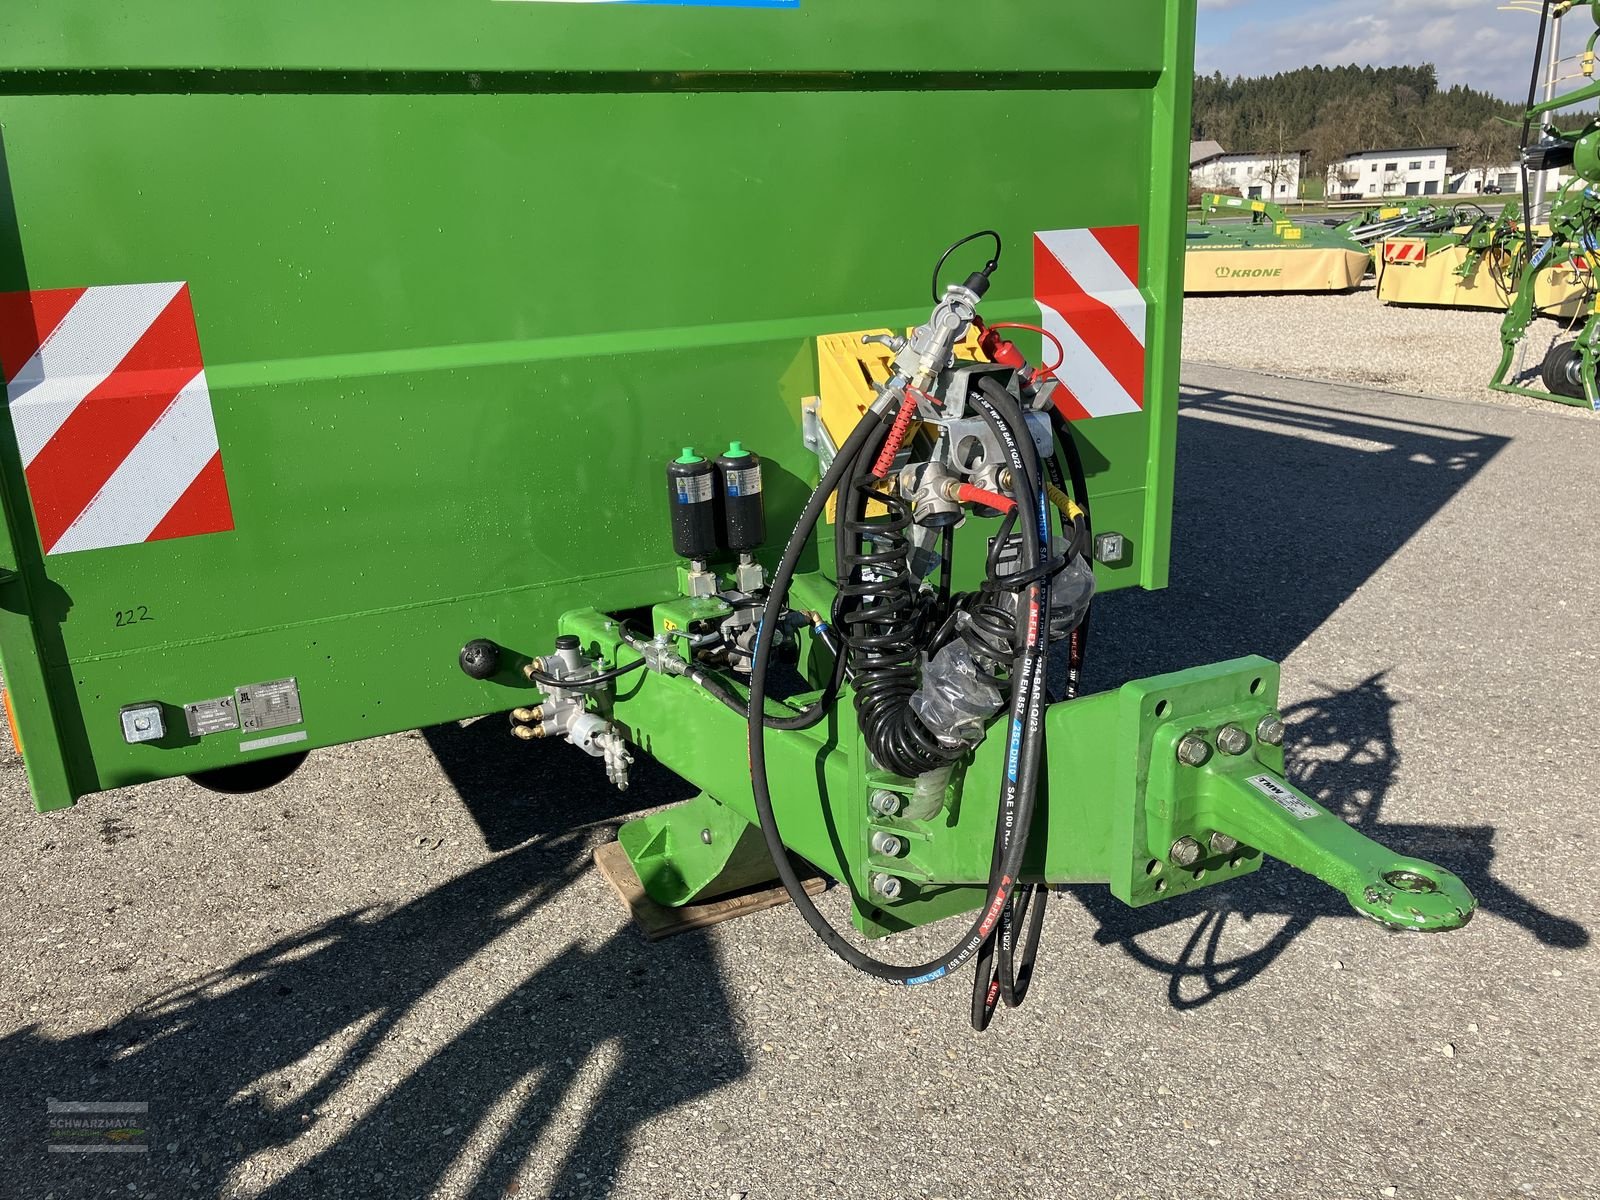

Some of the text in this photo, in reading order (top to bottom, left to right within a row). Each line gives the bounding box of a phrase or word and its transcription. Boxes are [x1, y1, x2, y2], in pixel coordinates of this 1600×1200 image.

[1231, 268, 1283, 278] KRONE
[1002, 431, 1015, 448] BAR
[115, 605, 154, 627] 222
[1027, 608, 1039, 648] M-FLEX
[1023, 658, 1032, 678] DIN
[1020, 680, 1029, 694] EN
[1031, 676, 1041, 702] BAR
[1017, 695, 1026, 715] 857
[1030, 702, 1040, 732] 1Q/23
[1011, 726, 1021, 746] 2SC
[1009, 747, 1018, 775] DN10
[1258, 777, 1284, 794] TMW
[1006, 786, 1015, 808] SAE
[1005, 810, 1014, 827] 100
[981, 896, 1003, 930] M-FLEX
[1003, 912, 1011, 929] BAR
[969, 936, 980, 951] DIN
[948, 959, 961, 970] 857
[959, 949, 970, 962] EN
